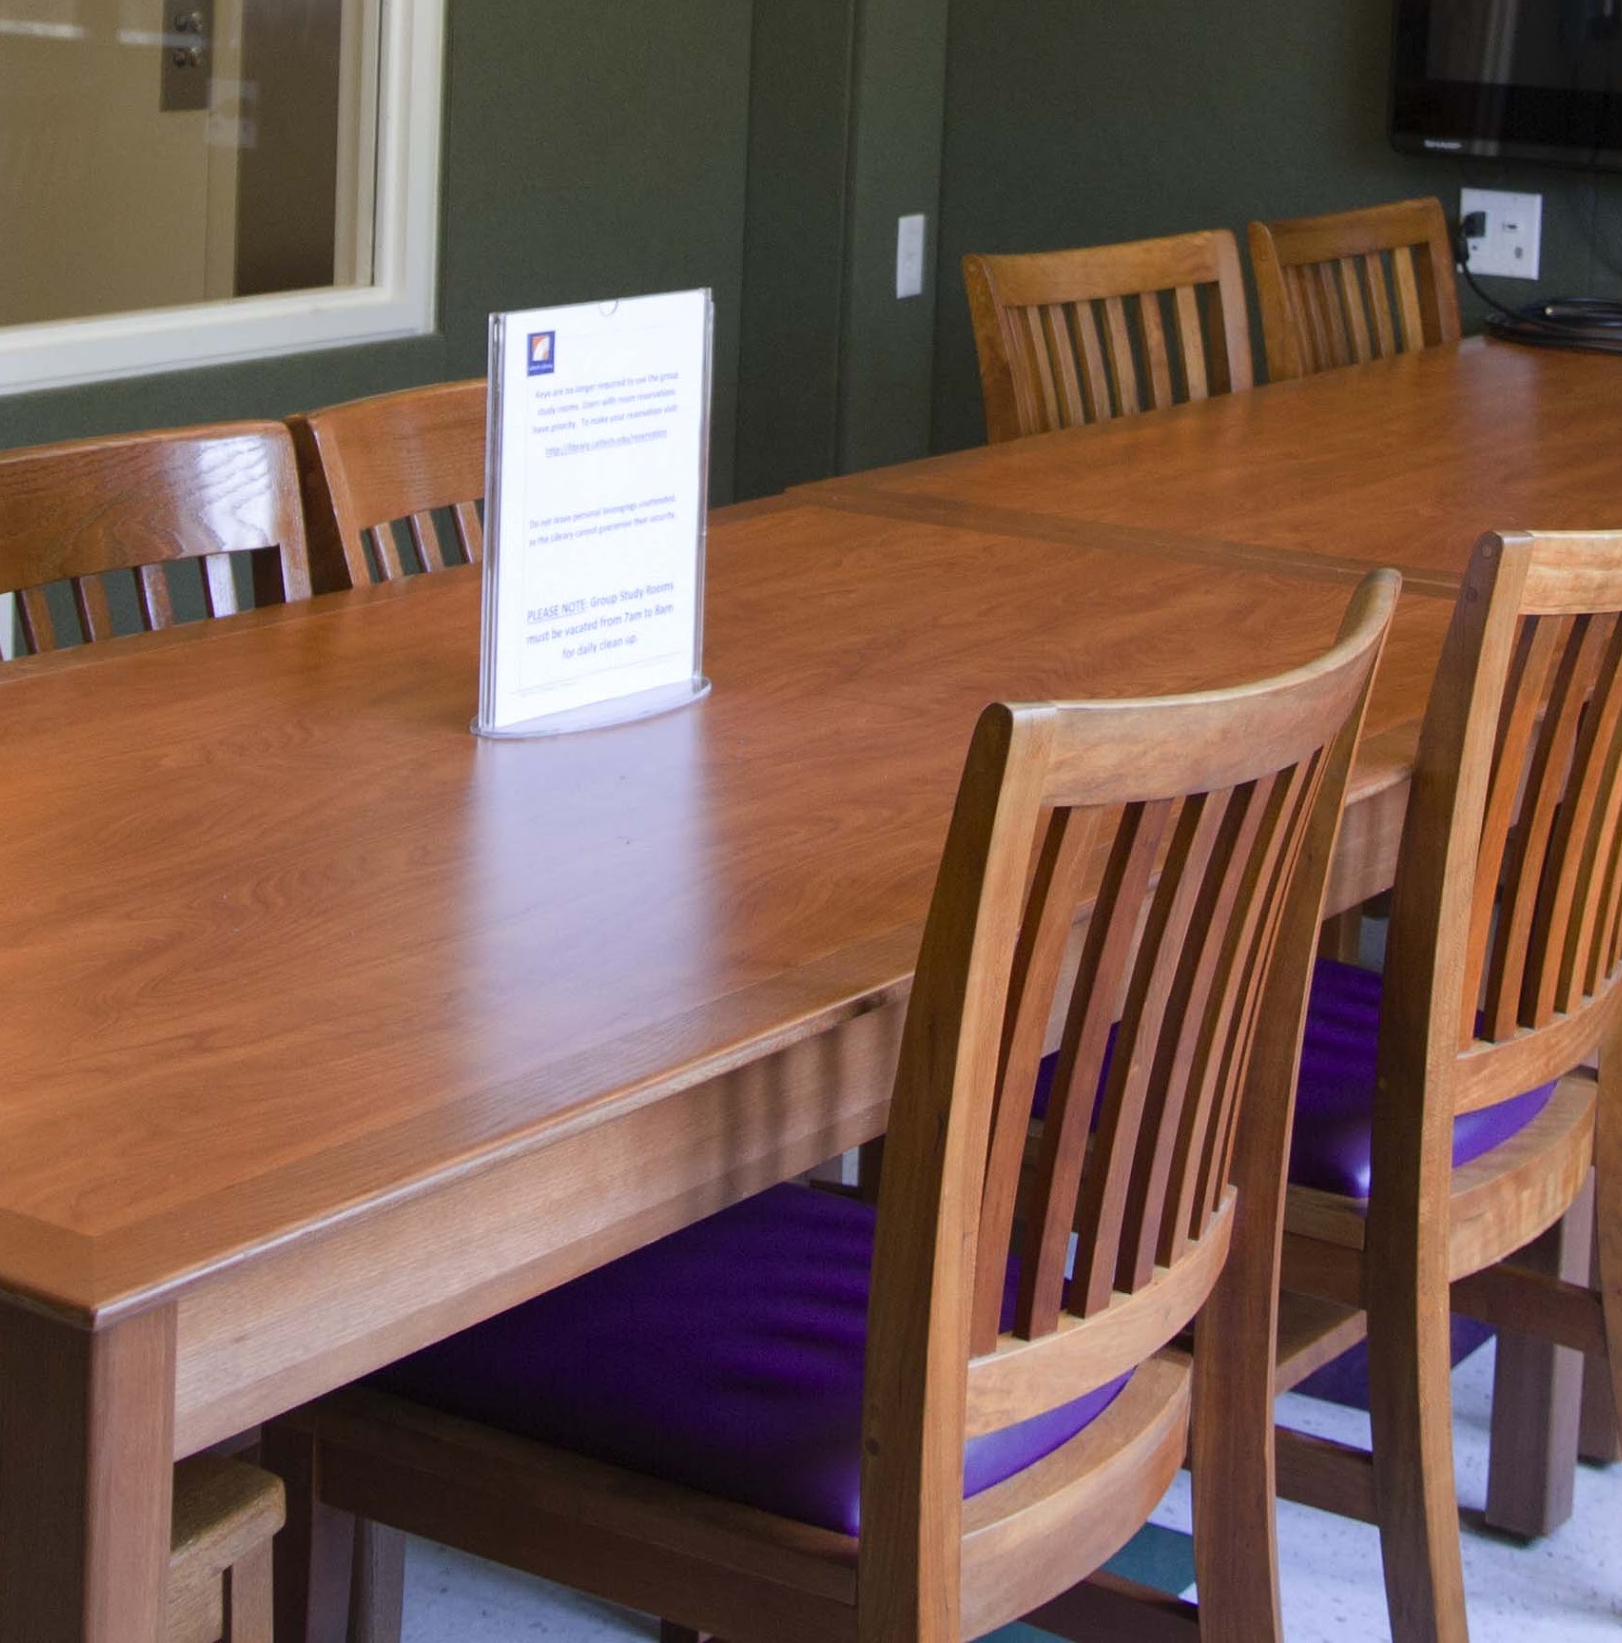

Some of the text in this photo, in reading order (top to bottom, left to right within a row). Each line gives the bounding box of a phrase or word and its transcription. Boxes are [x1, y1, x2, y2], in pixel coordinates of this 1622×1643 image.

[526, 604, 560, 622] PLEASE
[590, 594, 618, 609] Group
[619, 587, 644, 603] Study
[645, 581, 675, 595] Rooms
[526, 630, 550, 645] must
[551, 627, 563, 640] be
[564, 619, 599, 637] vacated
[600, 614, 623, 629] from
[623, 610, 643, 623] 7am
[644, 607, 654, 619] to
[561, 647, 575, 660] for
[577, 642, 598, 657] daily
[599, 636, 624, 651] clean
